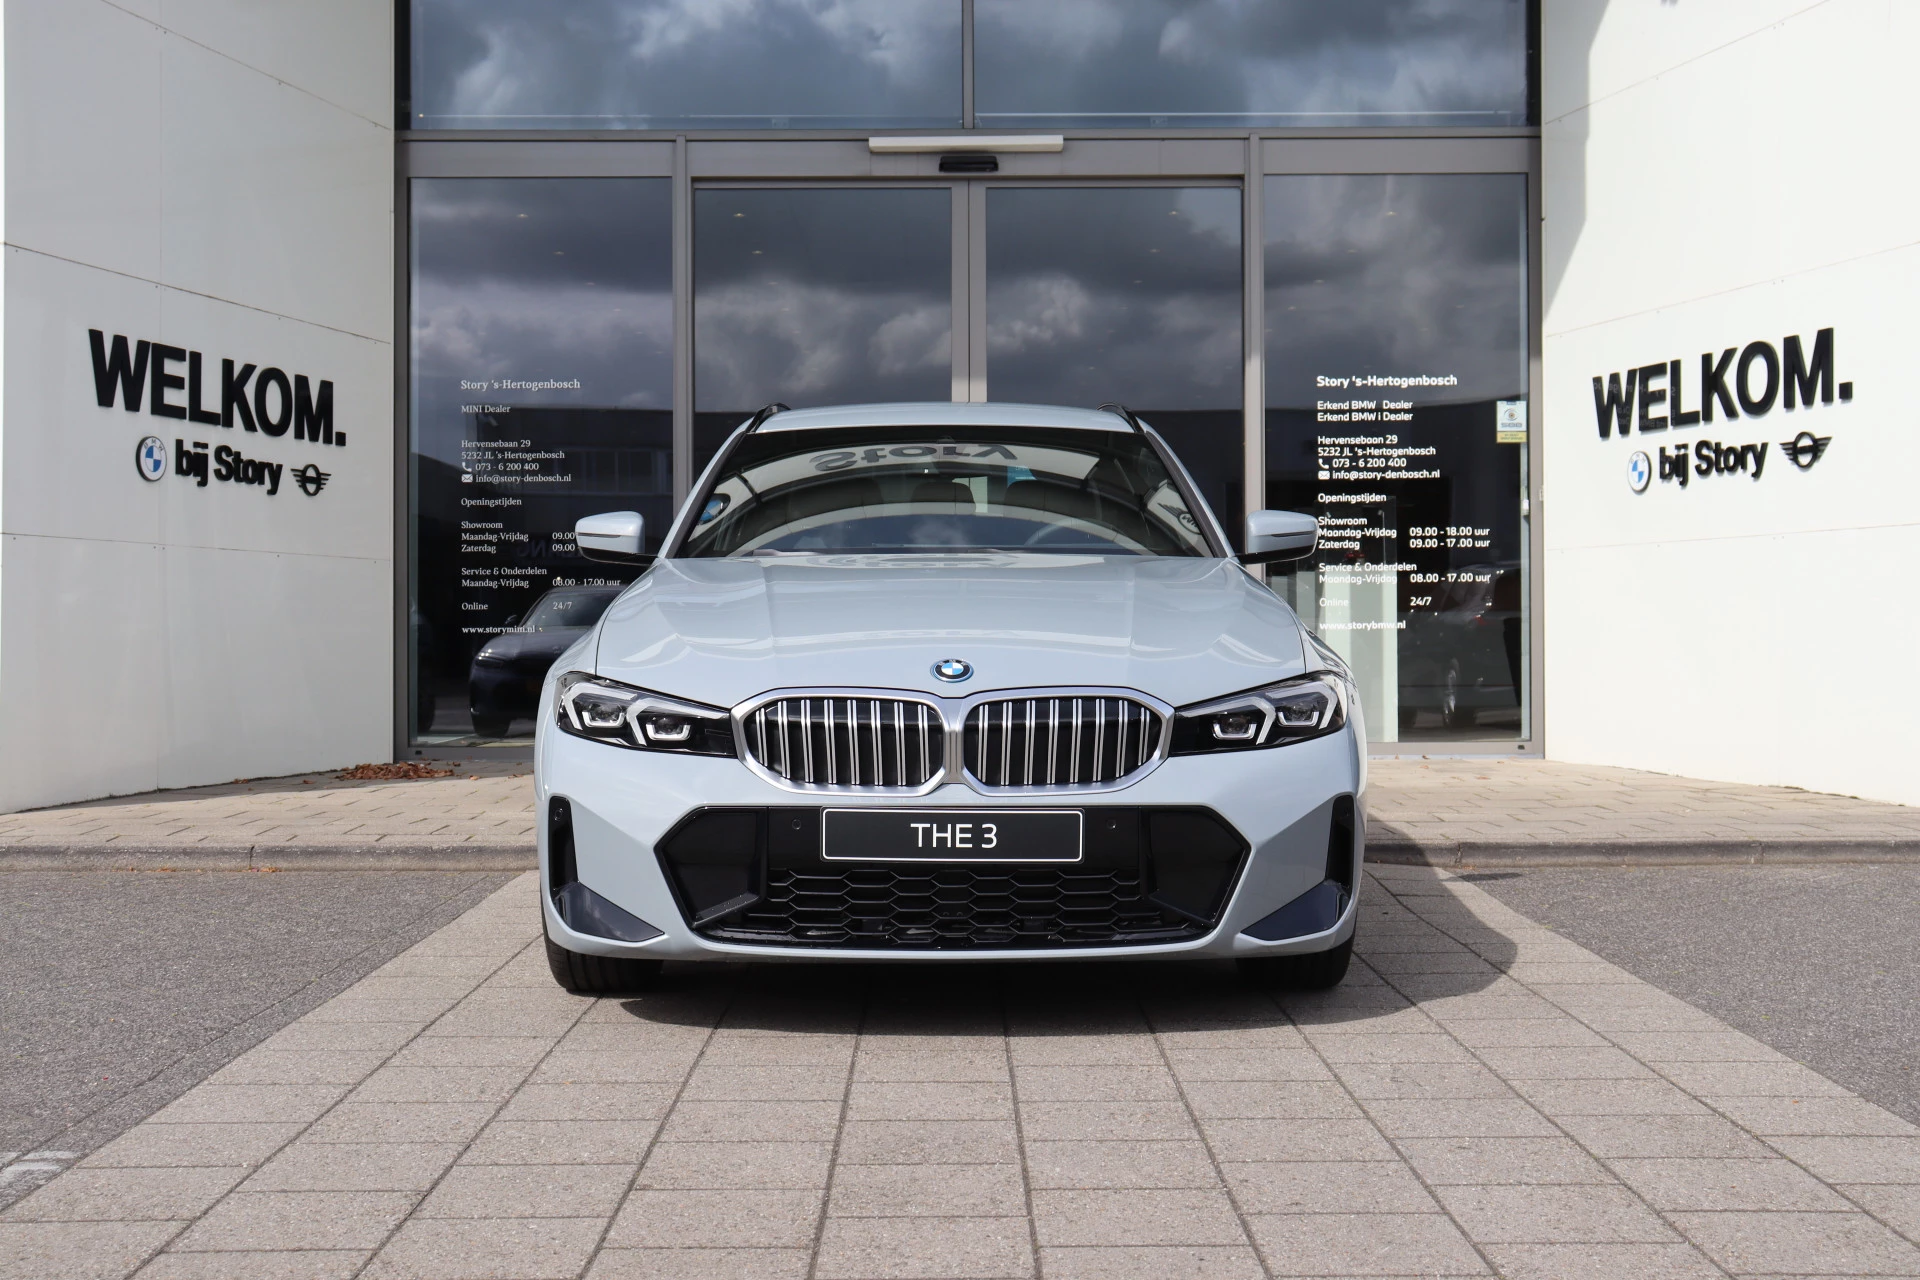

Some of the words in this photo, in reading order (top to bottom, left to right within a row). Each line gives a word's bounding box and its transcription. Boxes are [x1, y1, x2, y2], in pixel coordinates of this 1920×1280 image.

[460, 379, 488, 391] Story
[491, 379, 581, 391] 's-Hertogenbosch
[1316, 376, 1349, 389] Story
[1352, 375, 1458, 388] 's-Hertogenbosch
[1592, 327, 1853, 439] WELKOM.
[88, 328, 346, 447] WELKOM.
[461, 405, 483, 413] MINI
[484, 404, 511, 413] Dealer
[1317, 400, 1350, 410] Erkend
[1351, 400, 1377, 410] BMW
[1382, 400, 1413, 410] Dealer
[1317, 412, 1350, 422] Erkend
[1351, 412, 1377, 421] BMW
[1378, 412, 1381, 421] i
[1382, 412, 1414, 421] Dealer
[461, 439, 518, 448] Hervensebaan
[520, 439, 531, 448] 29
[1317, 435, 1384, 445] Hervensebaan
[1385, 434, 1398, 444] 29
[461, 451, 482, 460] 5232
[483, 451, 494, 460] JL
[495, 451, 565, 461] 's-Hertogenbosch
[1317, 446, 1341, 457] 5232
[1342, 446, 1353, 457] JL
[1354, 446, 1436, 458] 's-Hertogenbosch
[175, 438, 209, 487] bij
[213, 444, 283, 496] Story
[475, 463, 491, 471] 073
[498, 463, 504, 471] 6
[505, 463, 522, 471] 200
[523, 462, 540, 471] 400
[1332, 458, 1350, 468] 073
[1358, 458, 1365, 468] 6
[1366, 458, 1386, 468] 200
[1387, 458, 1407, 467] 400
[1659, 443, 1689, 487] bij
[1694, 439, 1769, 479] Story
[475, 473, 572, 484] info@story-denbosch.nl
[1332, 469, 1441, 480] info@story-denbosch.nl
[461, 498, 522, 508] Openingstijden
[1318, 493, 1387, 504] Openingstijden
[461, 521, 503, 529] Showroom
[1318, 516, 1368, 526] Showroom
[461, 532, 529, 542] Maandag-Vrijdag
[552, 532, 575, 540] 09.00
[1318, 527, 1397, 539] Maandag-Vrijdag
[1409, 527, 1438, 537] 09.00
[1445, 526, 1473, 536] 18.00
[1474, 528, 1491, 536] uur
[461, 544, 497, 553] Zaterdag
[552, 543, 576, 551] 09.00
[1318, 539, 1360, 550] Zaterdag
[1409, 538, 1438, 548] 09.00
[461, 567, 492, 575] Service
[493, 567, 499, 575] &
[500, 567, 547, 575] Onderdelen
[1319, 562, 1353, 572] Service
[1354, 562, 1362, 572] &
[1364, 562, 1417, 572] Onderdelen
[461, 579, 530, 589] Maandag-Vrijdag
[552, 578, 576, 586] 08.00
[583, 578, 605, 586] 17.00
[1319, 574, 1398, 585] Maandag-Vrijdag
[1410, 573, 1439, 583] 08.00
[1475, 574, 1491, 582] uur
[461, 602, 489, 610] Online
[552, 602, 573, 610] 24/7
[1319, 597, 1349, 607] Online
[1410, 597, 1432, 606] 24/7
[461, 625, 536, 635] www.storymini.nl
[1319, 620, 1406, 631] www.storybmw.nl
[910, 823, 973, 848] THE
[981, 823, 998, 849] 3
